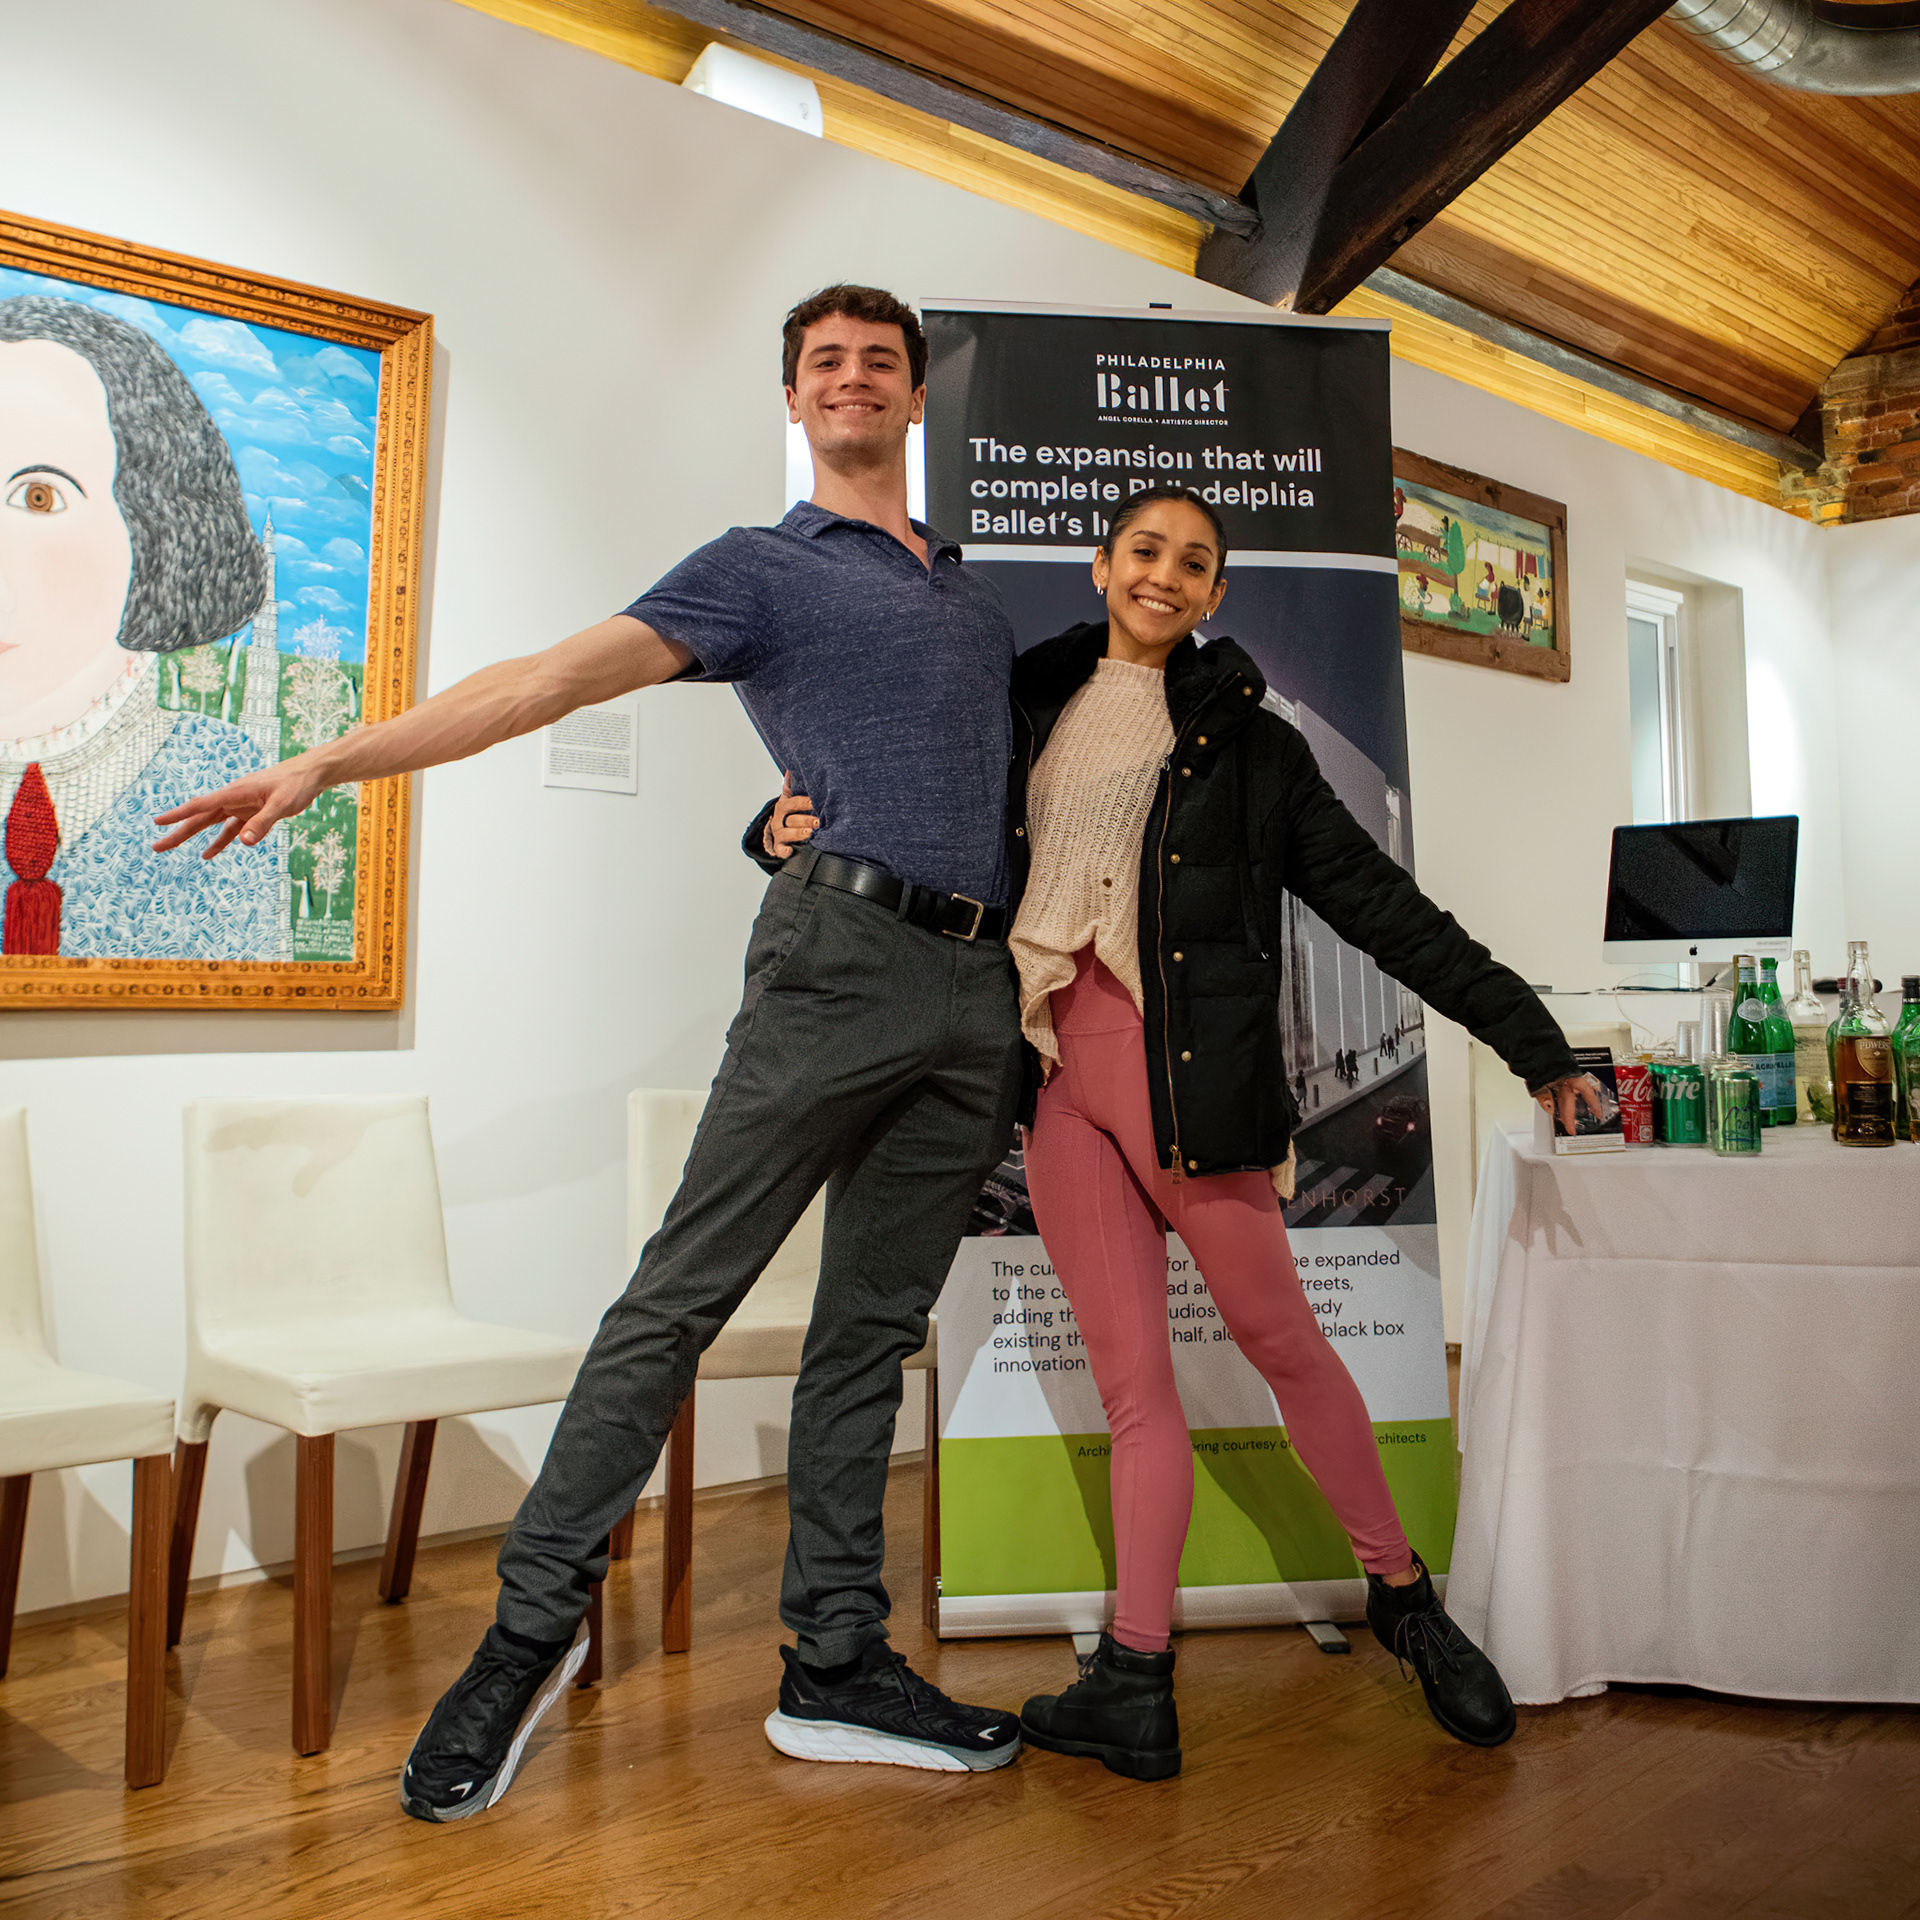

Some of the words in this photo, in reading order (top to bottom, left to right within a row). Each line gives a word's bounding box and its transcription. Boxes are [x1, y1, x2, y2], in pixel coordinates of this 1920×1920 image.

[1096, 354, 1226, 371] PHILADELPHIA
[1096, 373, 1230, 412] Ballet
[1122, 416, 1153, 424] CORELLA
[1161, 418, 1193, 426] ARTISTIC
[1194, 419, 1229, 427] DIRECTOR
[969, 437, 1028, 464] The
[1036, 444, 1193, 471] expansion
[1202, 445, 1266, 471] that
[1273, 448, 1322, 472] will
[970, 475, 1121, 506] complete
[971, 508, 1084, 536] Ballet's
[991, 1261, 1024, 1277] The
[1166, 1256, 1189, 1272] for
[1315, 1249, 1400, 1270] expanded
[992, 1287, 1010, 1301] to
[1017, 1284, 1045, 1300] the
[1300, 1276, 1353, 1291] treets,
[993, 1307, 1053, 1328] adding
[1169, 1303, 1216, 1319] udios
[993, 1331, 1061, 1351] existing
[1172, 1326, 1207, 1343] half,
[1322, 1320, 1368, 1337] black
[1373, 1320, 1405, 1335] box
[994, 1355, 1086, 1373] innovation
[1223, 1440, 1277, 1451] courtesy
